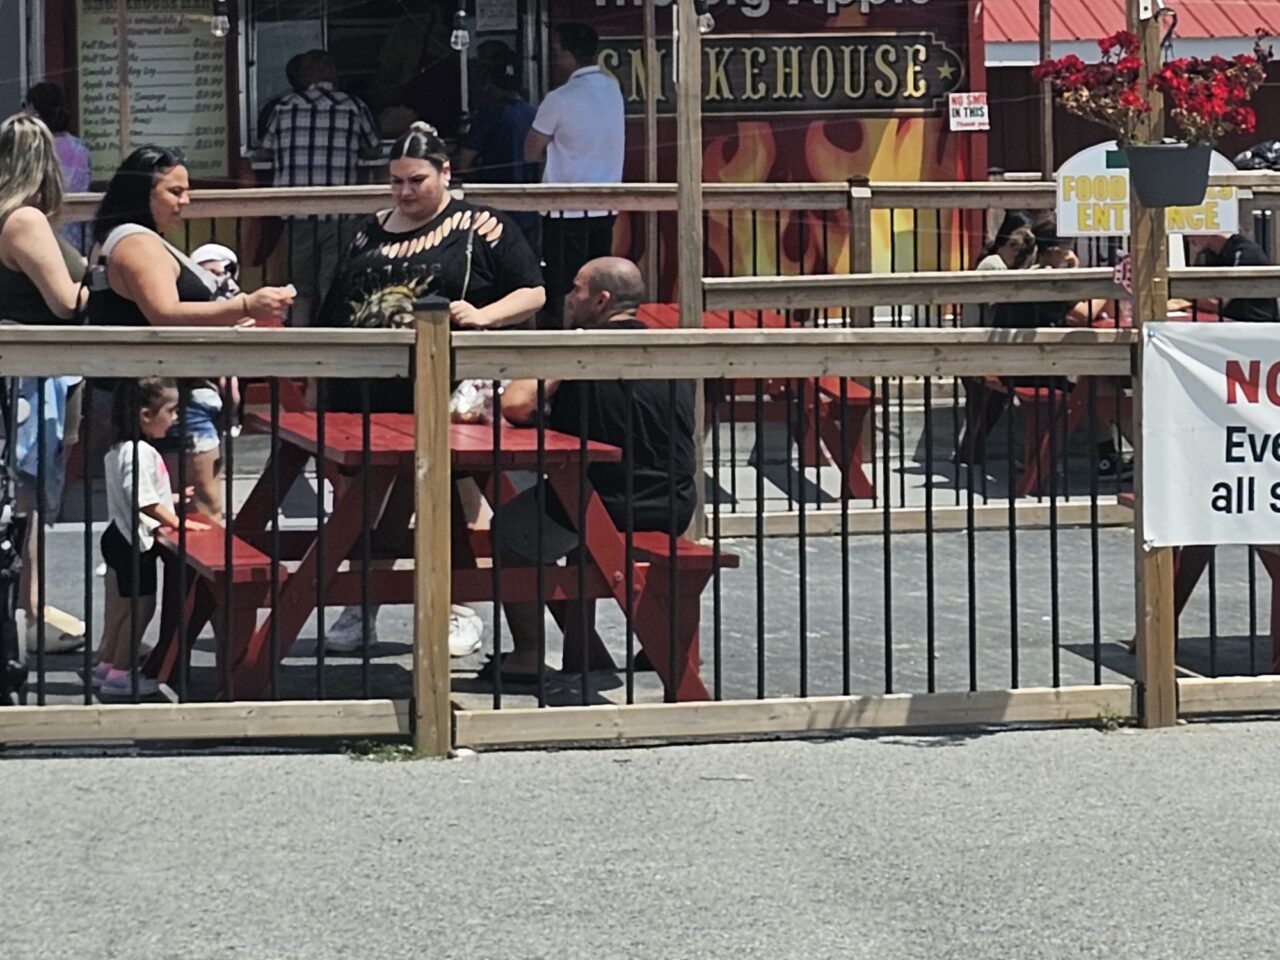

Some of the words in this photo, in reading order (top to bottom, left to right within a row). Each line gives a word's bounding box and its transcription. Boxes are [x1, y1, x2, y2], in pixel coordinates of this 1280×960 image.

[597, 43, 927, 102] SMKEHOUSE
[951, 106, 961, 118] IN
[963, 106, 985, 118] THIS
[1062, 175, 1127, 202] FOOD
[1077, 202, 1221, 233] ENTNCE
[1211, 477, 1255, 514] all
